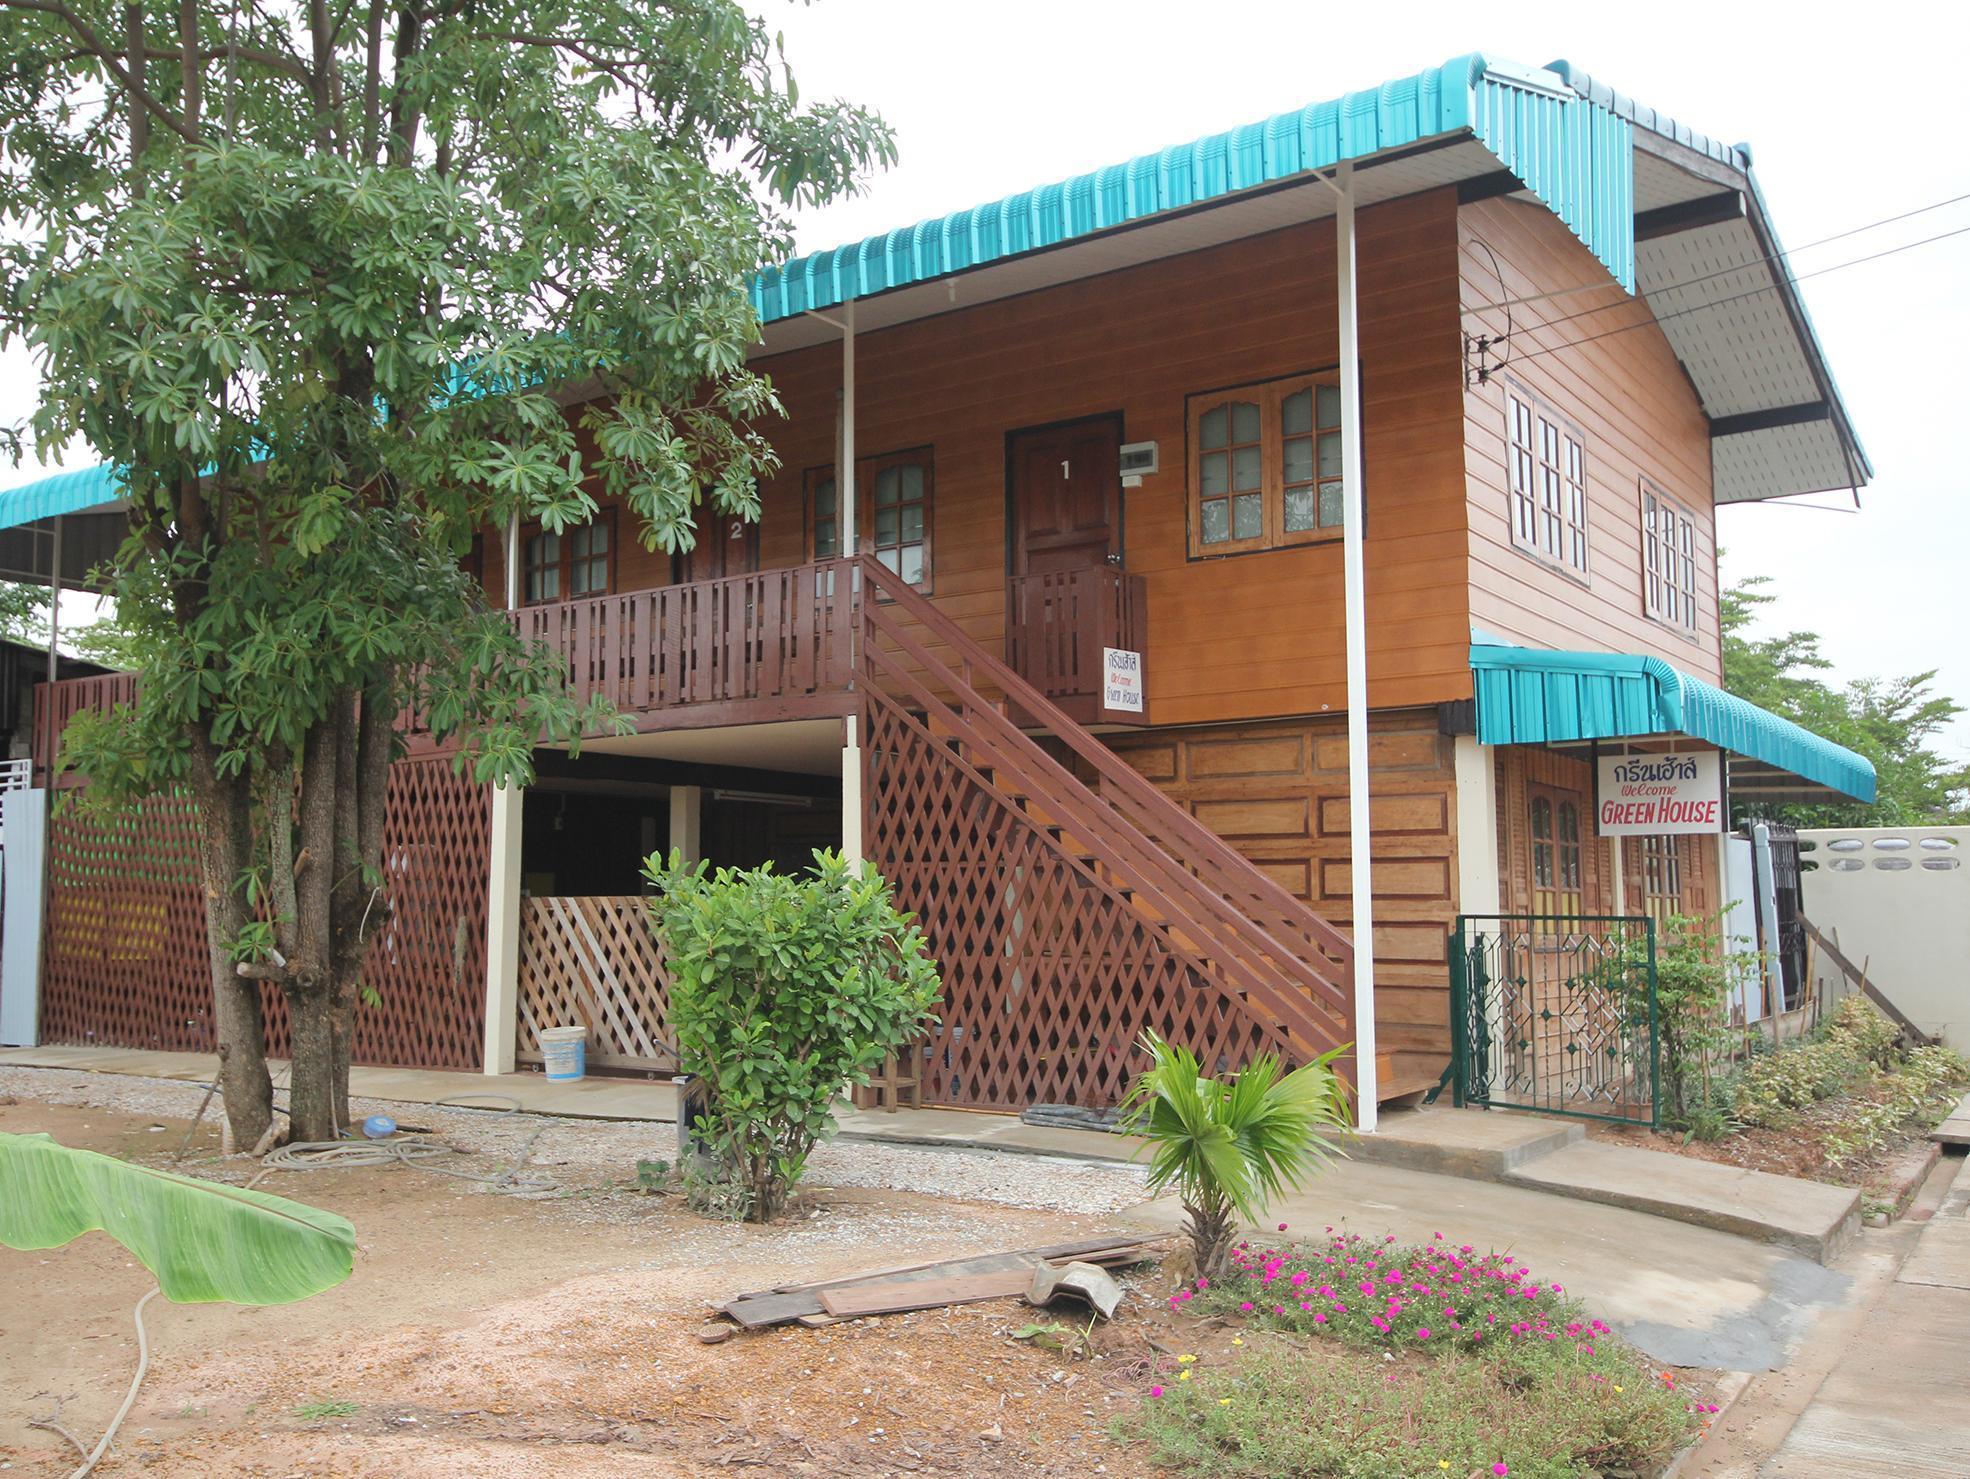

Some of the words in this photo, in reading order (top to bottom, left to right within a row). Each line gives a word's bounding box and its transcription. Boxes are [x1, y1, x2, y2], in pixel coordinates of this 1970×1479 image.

[1060, 460, 1069, 480] 1
[730, 521, 743, 539] 2
[1621, 783, 1678, 797] Welcome
[1601, 799, 1656, 825] GREEN
[1658, 796, 1718, 824] HOUSE
